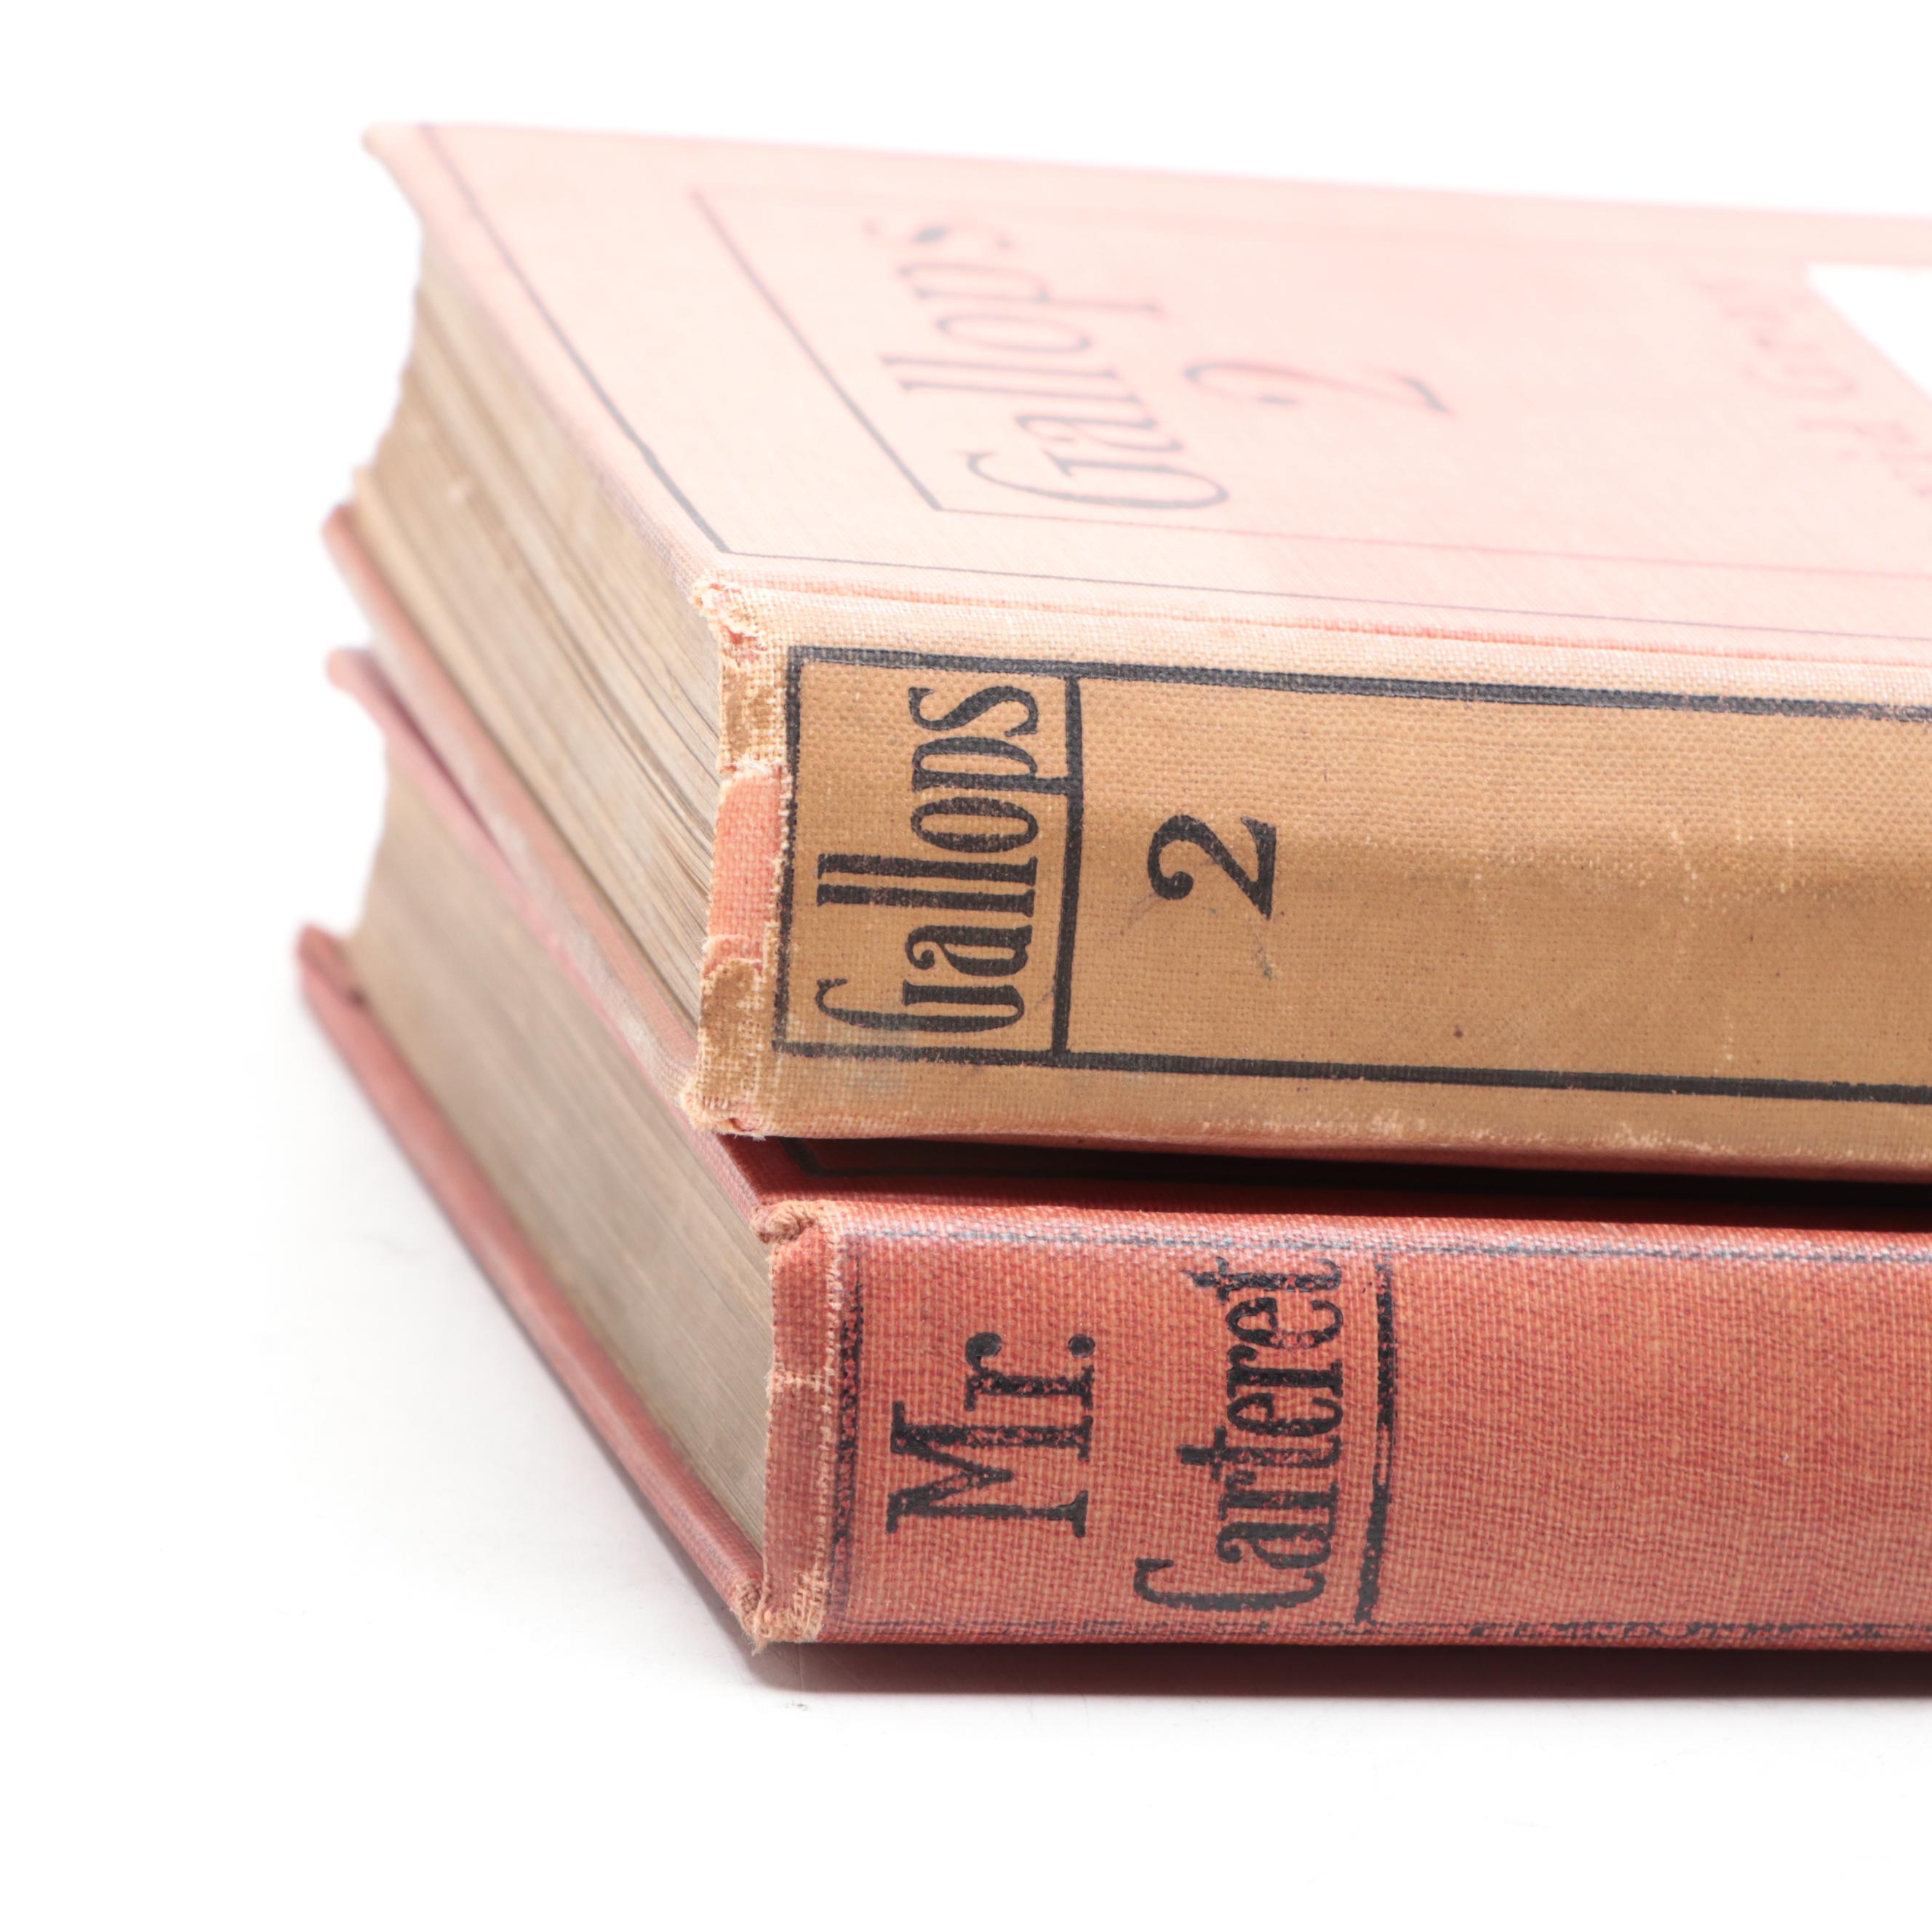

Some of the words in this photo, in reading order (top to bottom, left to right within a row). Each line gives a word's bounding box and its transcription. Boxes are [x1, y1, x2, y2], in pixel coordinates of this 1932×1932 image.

[861, 217, 1230, 511] Gallops
[1180, 356, 1456, 417] 2
[817, 685, 1069, 1033] Gallops
[1147, 814, 1277, 921] 2
[885, 1332, 1095, 1538] Mr.
[1133, 1256, 1344, 1612] Carteret
